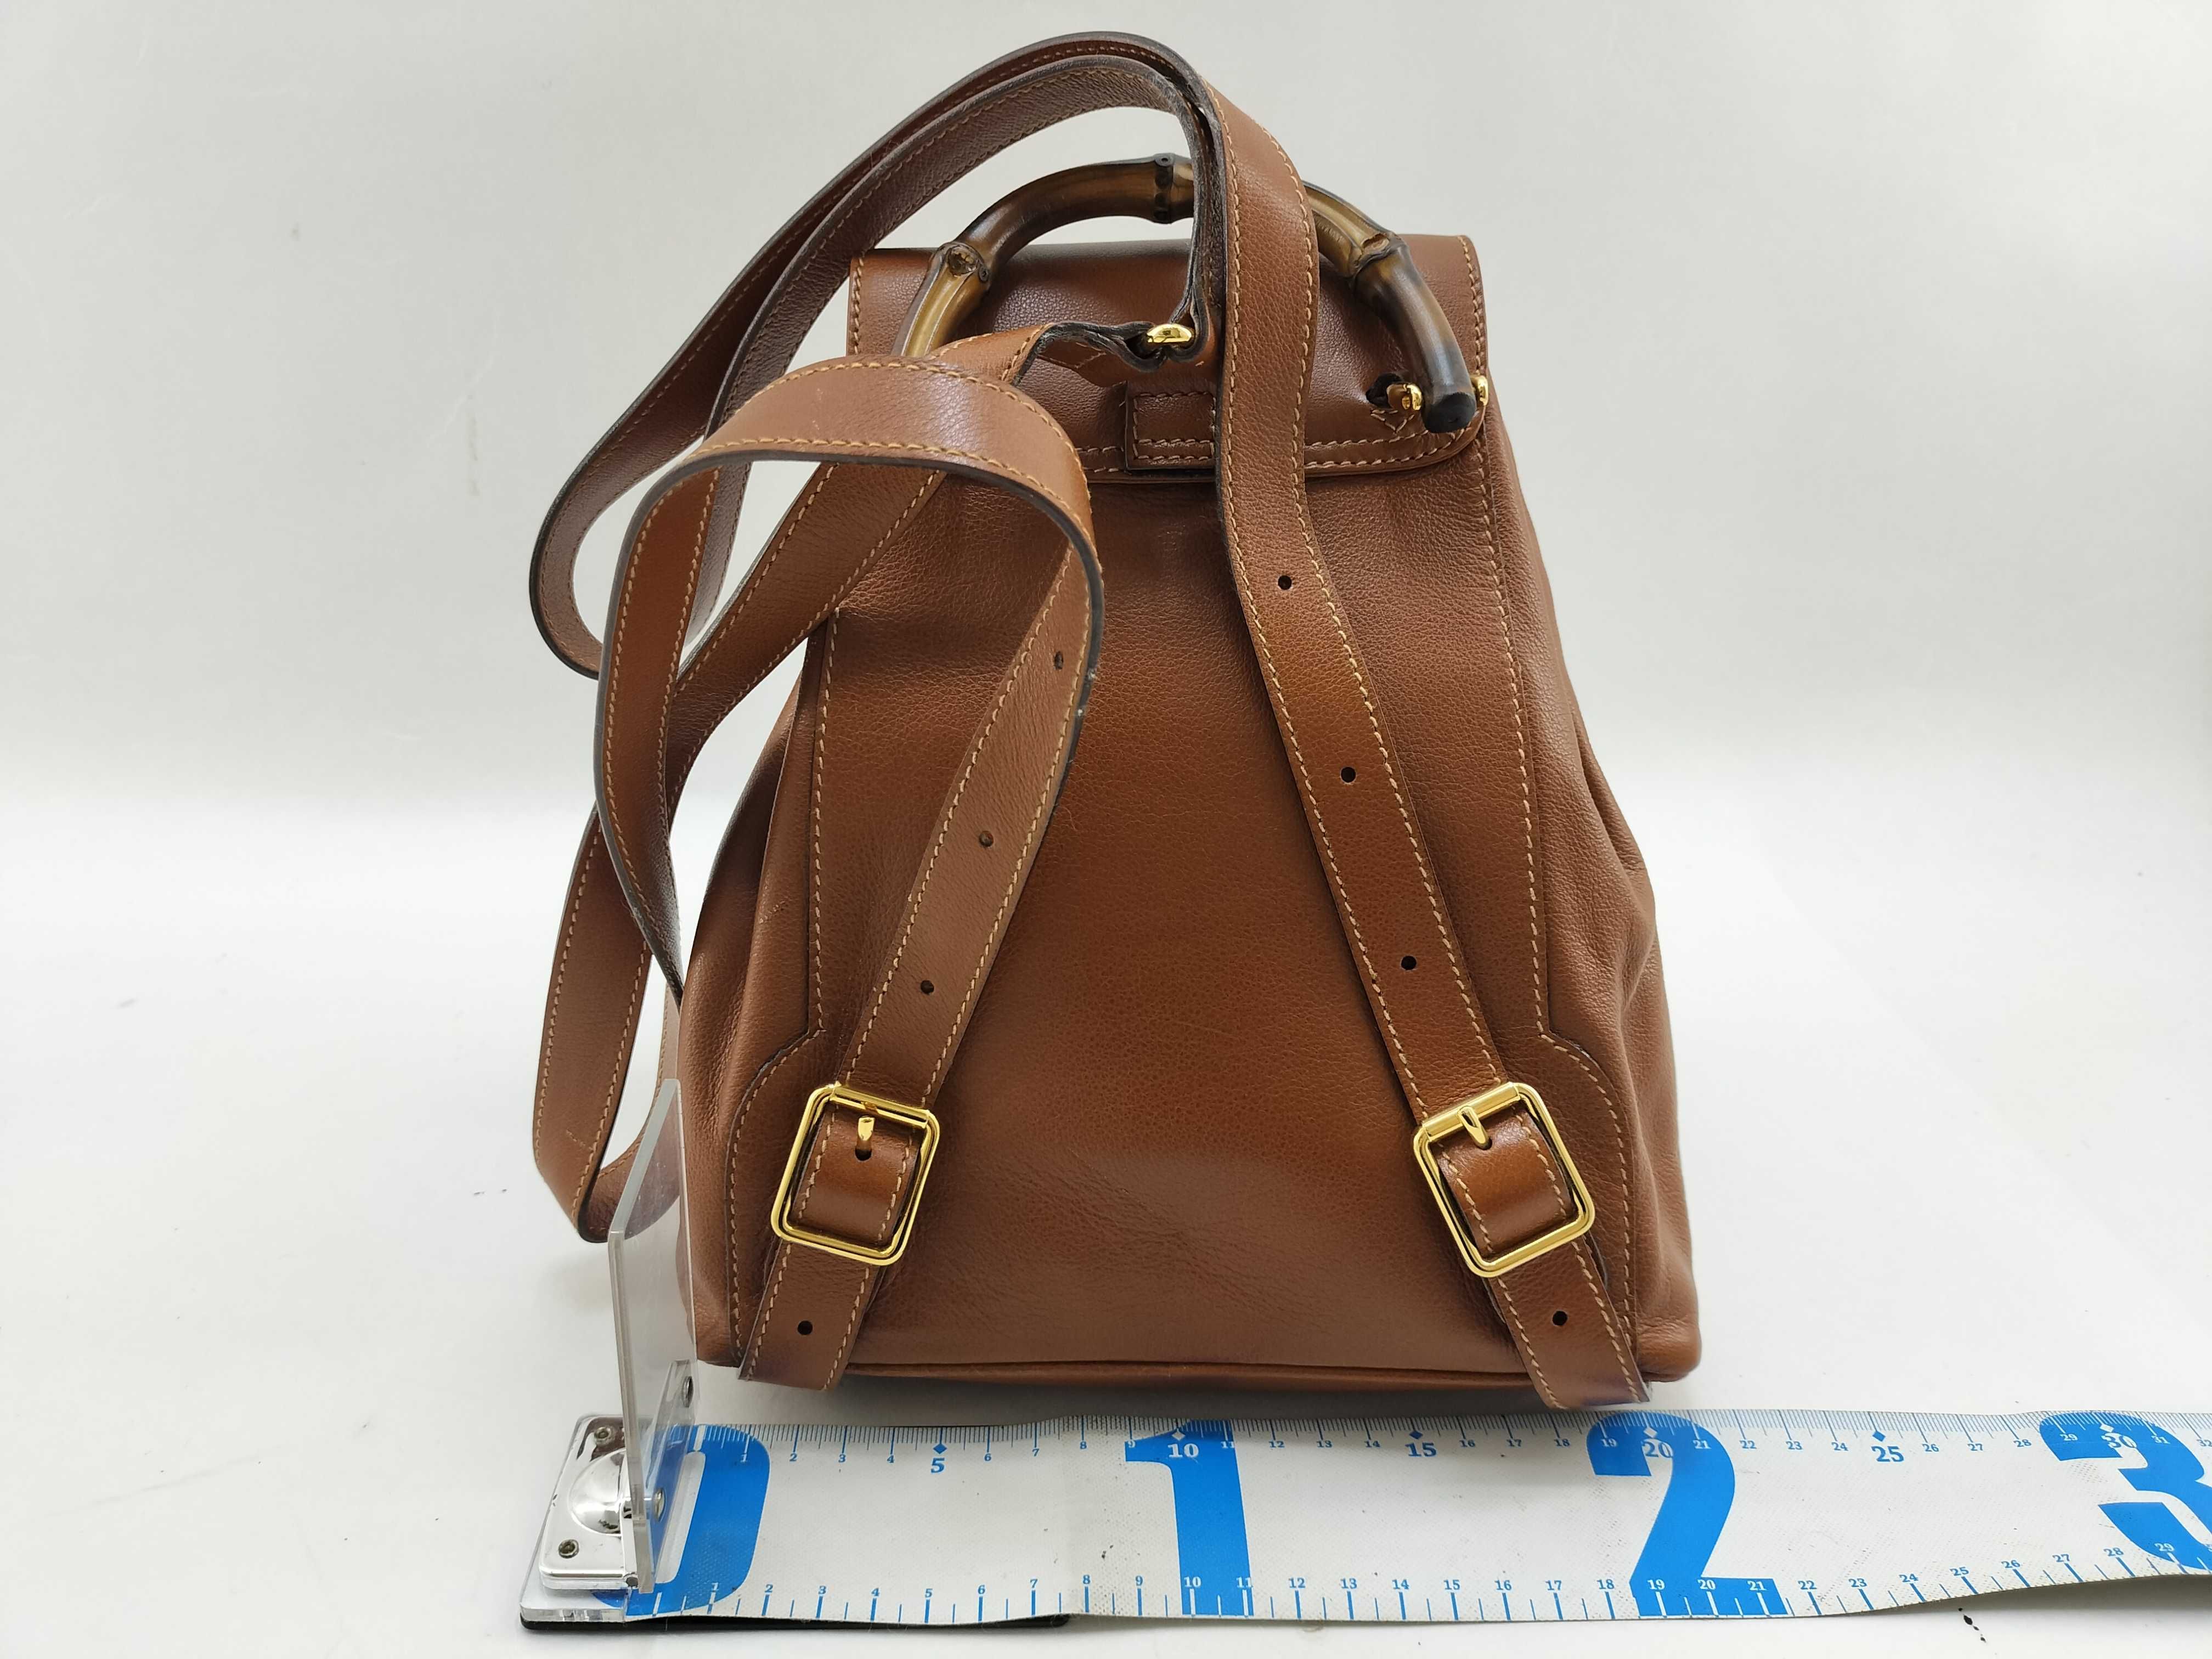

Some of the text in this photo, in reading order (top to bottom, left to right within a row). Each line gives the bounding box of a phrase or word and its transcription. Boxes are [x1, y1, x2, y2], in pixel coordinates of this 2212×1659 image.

[741, 1453, 747, 1462] 1
[790, 1454, 798, 1462] 2
[838, 1454, 846, 1463] 3
[887, 1454, 894, 1463] 4
[931, 1458, 945, 1473] 5
[984, 1453, 992, 1462] 6
[1032, 1448, 1040, 1457] 7
[1080, 1441, 1087, 1450] 8
[1128, 1441, 1136, 1449] 9
[1167, 1443, 1199, 1458] 10
[1317, 1440, 1333, 1448] 13
[1365, 1440, 1380, 1448] 14
[1405, 1442, 1437, 1457] 15
[1459, 1439, 1476, 1447] 16
[1506, 1438, 1522, 1447] 17
[1554, 1438, 1570, 1447] 18
[1601, 1438, 1617, 1447] 19
[1644, 1442, 1673, 1458] 20
[1693, 1440, 1712, 1449] 21
[1740, 1440, 1757, 1449] 22
[1786, 1441, 1803, 1450] 23
[1831, 1442, 1848, 1451] 24
[1871, 1446, 1904, 1462] 25
[1922, 1443, 1939, 1453] 26
[1967, 1443, 1984, 1452] 27
[2060, 1434, 2078, 1442] 29
[2102, 1436, 2136, 1449] 30
[2152, 1436, 2170, 1444] 31
[1125, 1419, 1254, 1615] 1
[1587, 1410, 1788, 1615] 2
[2039, 1412, 2212, 1570] 3
[765, 1584, 773, 1593] 2
[819, 1585, 826, 1594] 3
[871, 1588, 880, 1596] 4
[925, 1588, 932, 1598] 5
[978, 1585, 985, 1594] 6
[1030, 1579, 1038, 1588] 7
[1082, 1575, 1091, 1584] 8
[1135, 1576, 1143, 1585] 9
[1184, 1577, 1201, 1587] 10
[1236, 1577, 1252, 1587] 11
[1289, 1578, 1306, 1588] 12
[1340, 1578, 1357, 1589] 13
[1392, 1579, 1409, 1590] 14
[1443, 1579, 1460, 1590] 15
[1494, 1580, 1512, 1590] 16
[1545, 1579, 1562, 1590] 17
[1597, 1579, 1615, 1590] 18
[1647, 1579, 1664, 1590] 19
[1698, 1579, 1716, 1590] 20
[1747, 1581, 1766, 1591] 21
[1798, 1580, 1816, 1590] 22
[1848, 1578, 1867, 1588] 23
[1899, 1573, 1918, 1583] 24
[1949, 1566, 1970, 1576] 25
[2001, 1560, 2021, 1568] 26
[2052, 1554, 2071, 1562] 27
[2104, 1548, 2124, 1557] 28
[2154, 1543, 2174, 1552] 29
